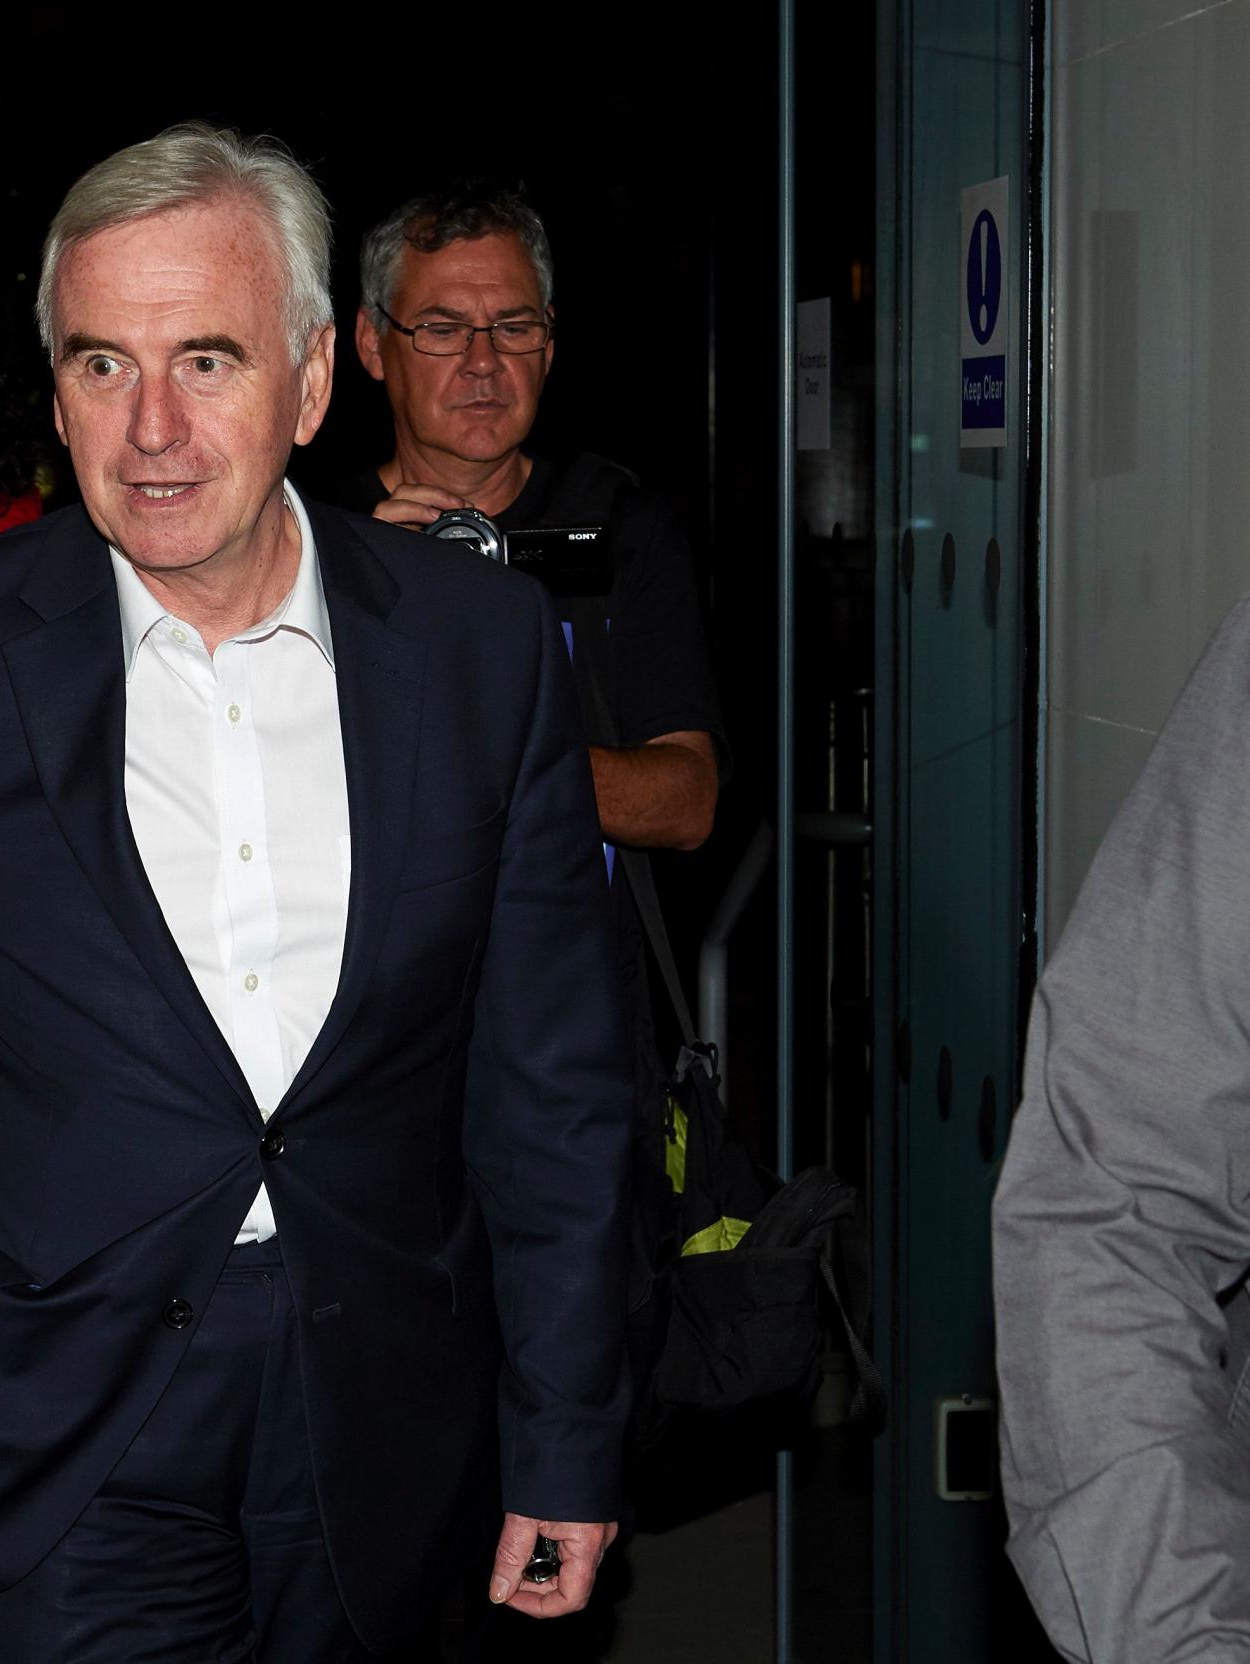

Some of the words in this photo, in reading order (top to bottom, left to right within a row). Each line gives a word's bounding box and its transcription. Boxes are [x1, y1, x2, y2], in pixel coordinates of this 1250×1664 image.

[963, 375, 982, 407] Keep
[983, 374, 1003, 401] Clear
[568, 533, 598, 541] SONY
